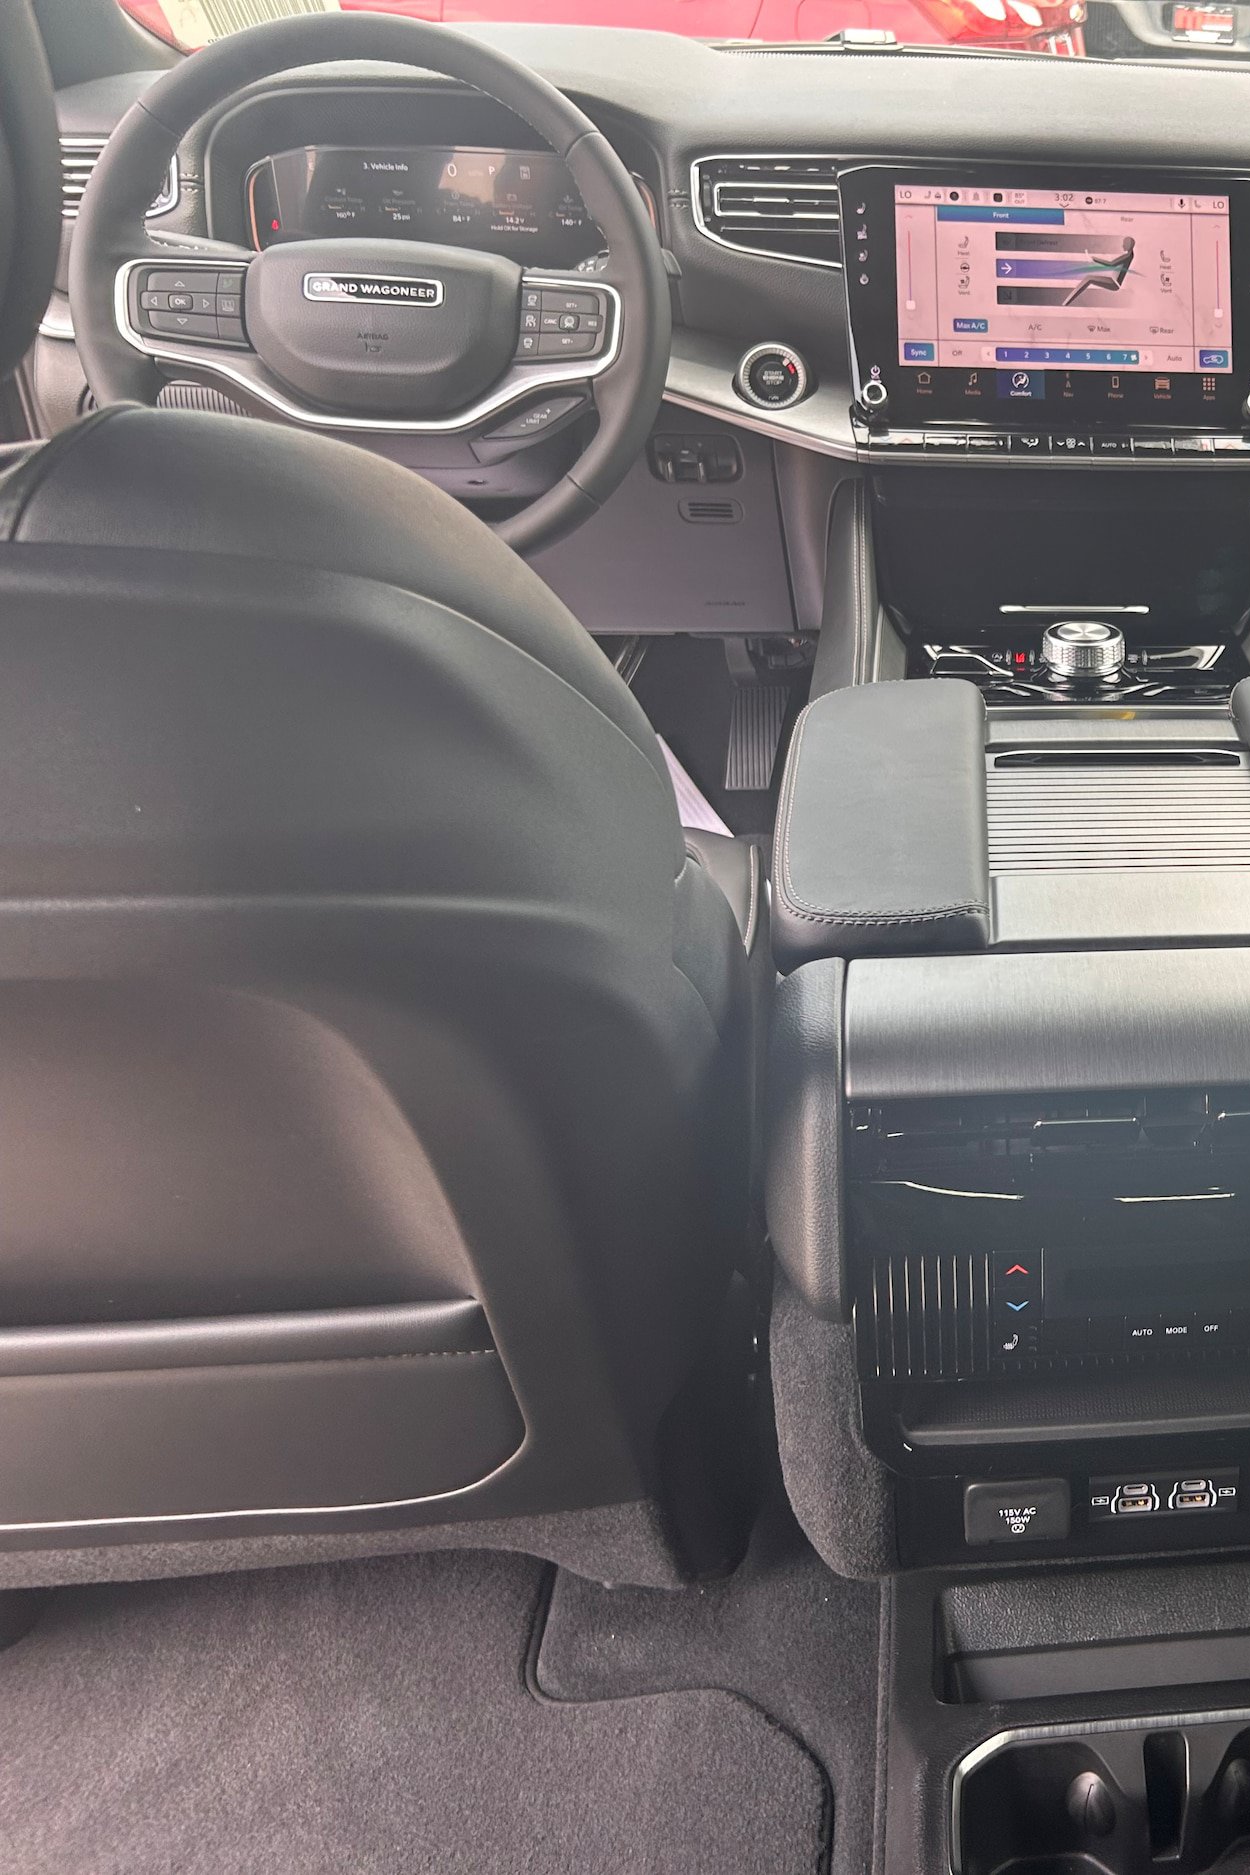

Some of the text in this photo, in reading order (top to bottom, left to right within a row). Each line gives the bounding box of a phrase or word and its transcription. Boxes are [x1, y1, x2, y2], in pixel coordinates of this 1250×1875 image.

[371, 163, 394, 171] Vehicle
[489, 166, 495, 175] P
[900, 190, 912, 199] LO
[1212, 201, 1225, 210] LO
[992, 211, 1009, 219] Front
[313, 281, 435, 298] GRAND WAGONEER
[971, 322, 986, 330] A/C
[357, 332, 389, 340] AIRBAG
[910, 349, 927, 357] Sync
[1044, 352, 1050, 360] 3
[1065, 352, 1071, 360] 4
[1165, 1326, 1187, 1334] MODE
[1203, 1324, 1218, 1332] OFF
[999, 1506, 1036, 1517] 115V AC
[1005, 1516, 1030, 1524] 150W
